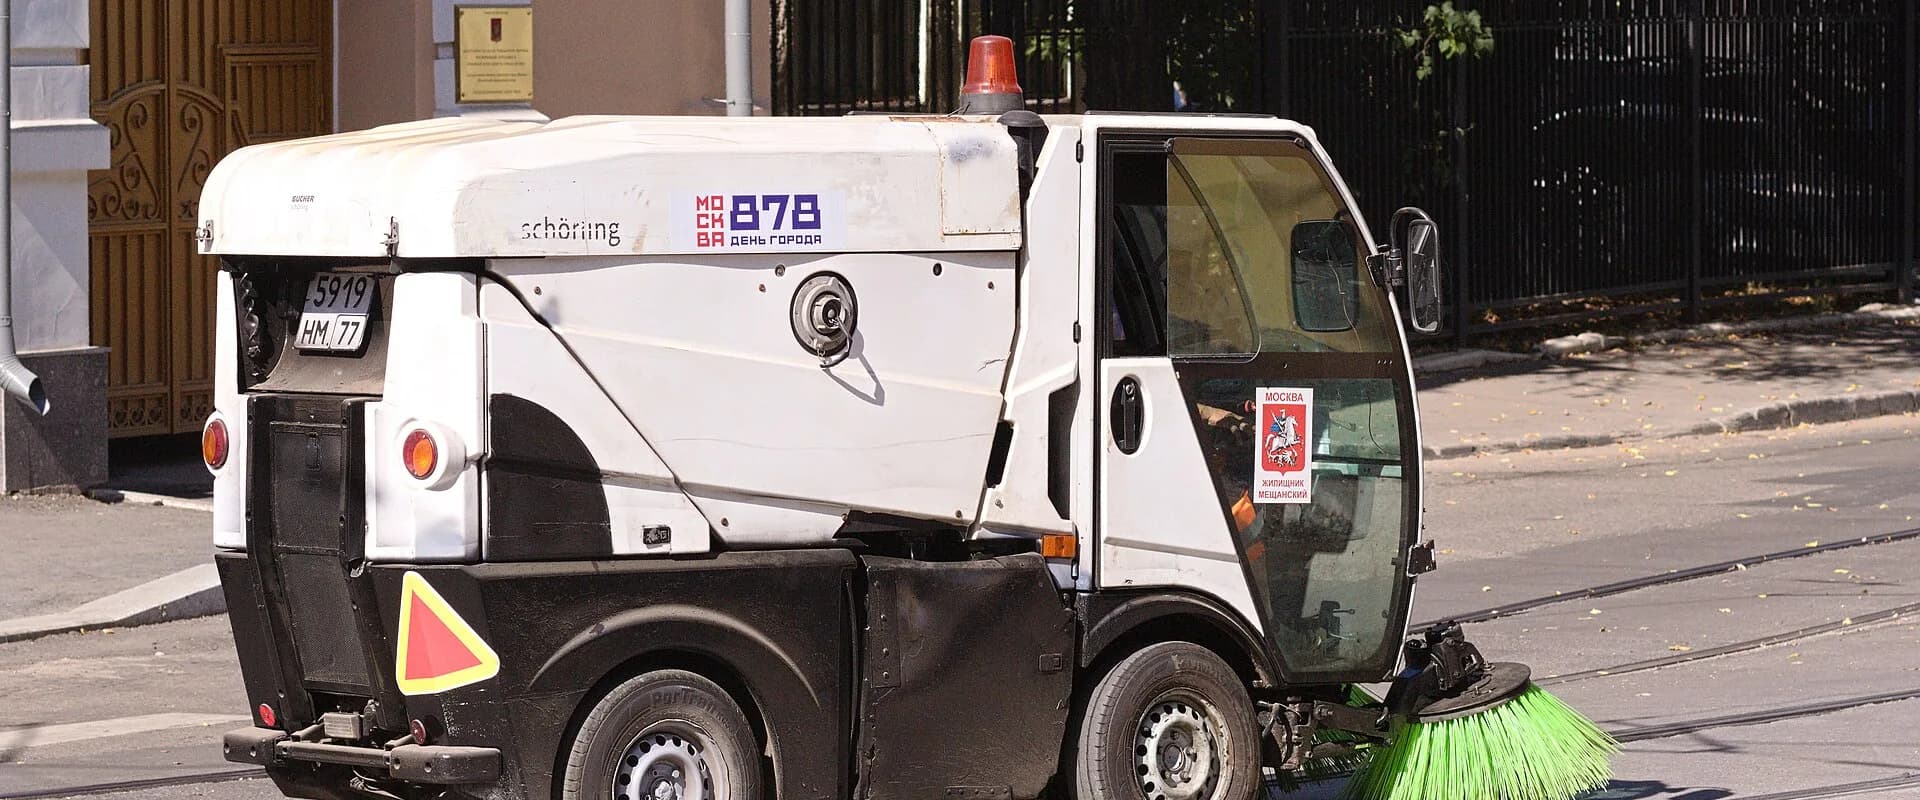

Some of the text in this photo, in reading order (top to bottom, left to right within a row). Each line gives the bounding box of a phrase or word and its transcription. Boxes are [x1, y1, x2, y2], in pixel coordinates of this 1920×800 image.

[292, 195, 315, 203] BUCHER
[696, 195, 724, 211] МО
[730, 194, 821, 231] 878
[696, 213, 724, 229] СК
[696, 231, 724, 247] ВА
[730, 234, 822, 247] ДЕНЬ ГОРОДА
[313, 275, 367, 309] 5919
[337, 320, 361, 346] 77
[1265, 392, 1304, 402] МОСКВА
[1262, 479, 1305, 488] ЖИЛИЩНИК
[1258, 489, 1308, 500] МЕЩАНСКИЙ
